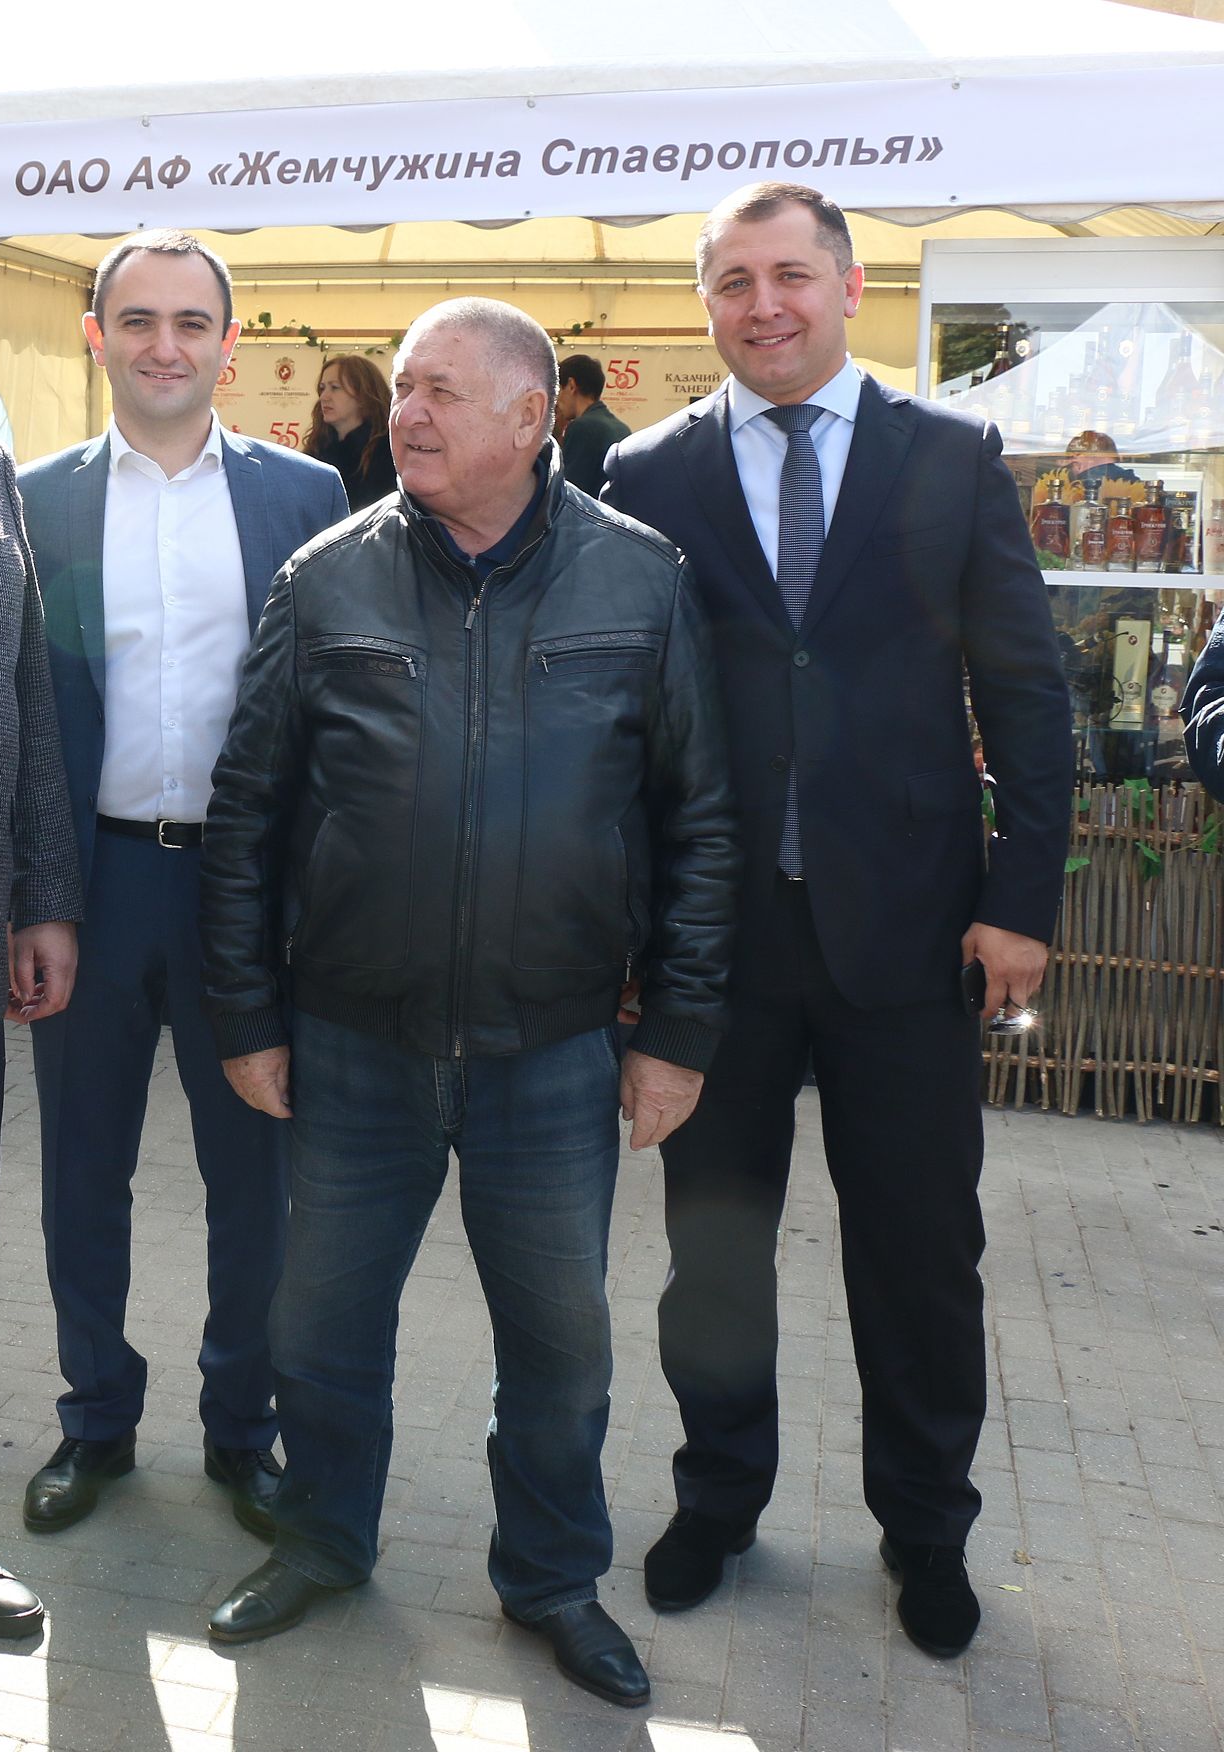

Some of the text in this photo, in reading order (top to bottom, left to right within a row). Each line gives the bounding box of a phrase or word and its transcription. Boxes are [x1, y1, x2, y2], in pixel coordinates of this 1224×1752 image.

[15, 135, 944, 197] ОАО АФ «Жемчужина Ставрополья»
[605, 359, 641, 390] 55
[664, 371, 721, 383] КАЗАЧИЙ
[672, 384, 713, 394] ТАНЕЦ
